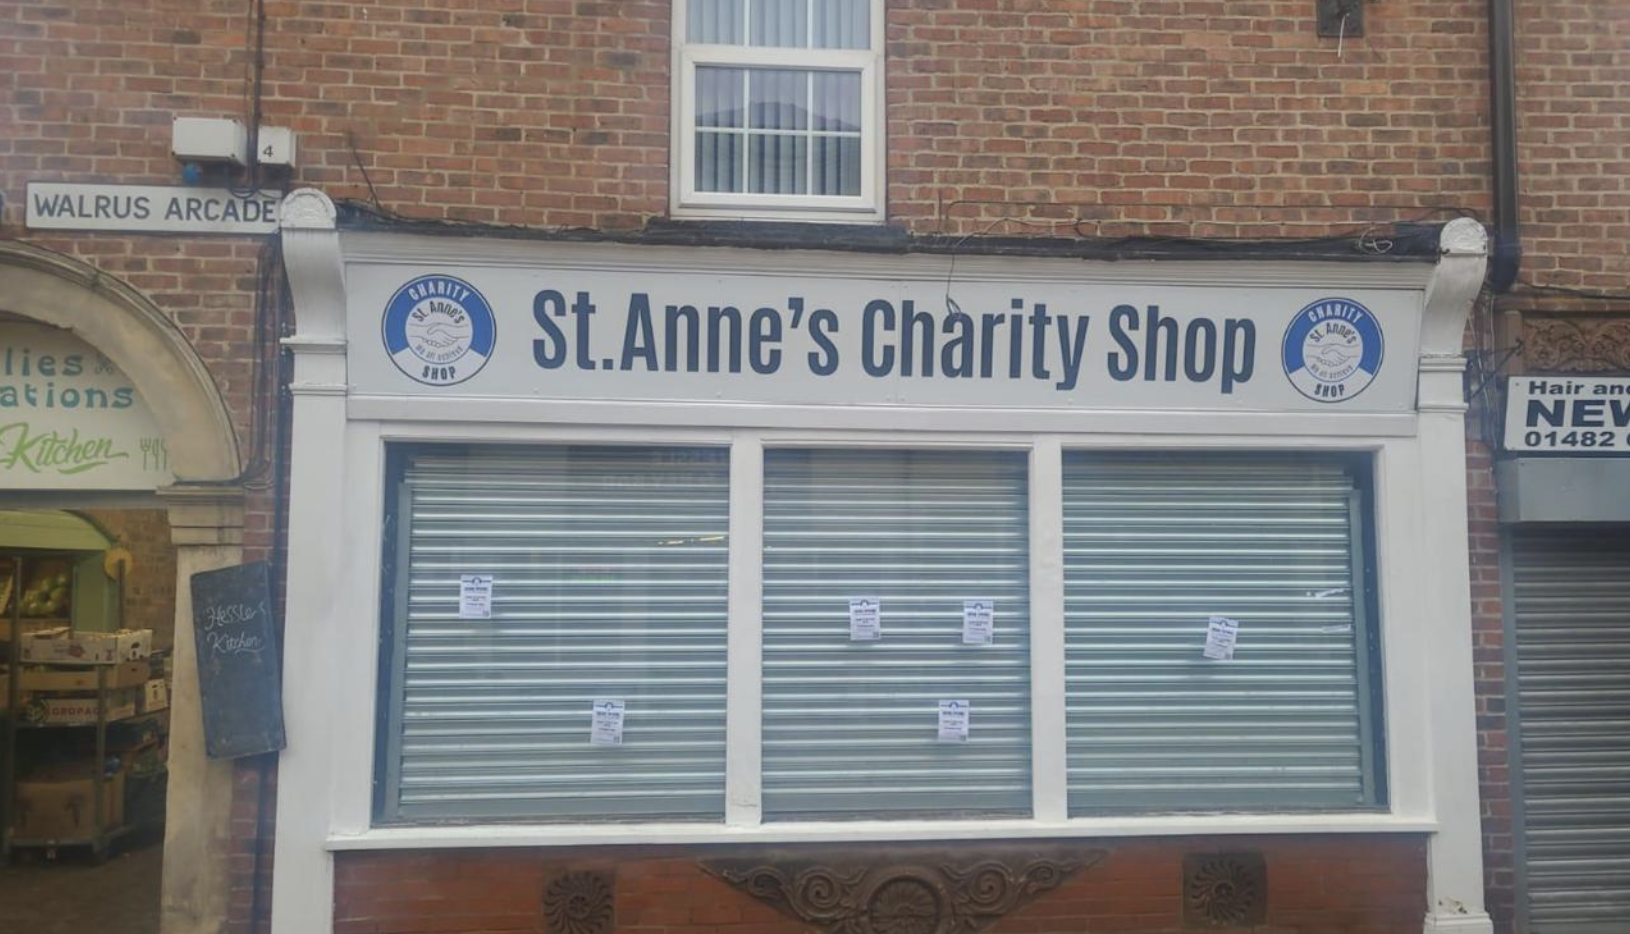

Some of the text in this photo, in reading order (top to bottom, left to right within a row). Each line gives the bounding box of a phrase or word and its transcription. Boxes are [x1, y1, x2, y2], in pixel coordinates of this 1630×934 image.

[263, 145, 274, 158] 4
[34, 193, 276, 223] WALRUS ARCADE
[408, 280, 471, 301] CHARITY
[429, 300, 465, 324] Anne's
[1308, 303, 1364, 323] CHARITY
[1326, 322, 1357, 344] Anne's
[861, 298, 1090, 391] Charity
[1107, 304, 1257, 395] Shop
[422, 365, 456, 380] SHOP
[1314, 383, 1345, 397] SHOP
[1529, 381, 1585, 395] Hair
[0, 422, 130, 474] Kitchen
[1524, 431, 1615, 447] 01482
